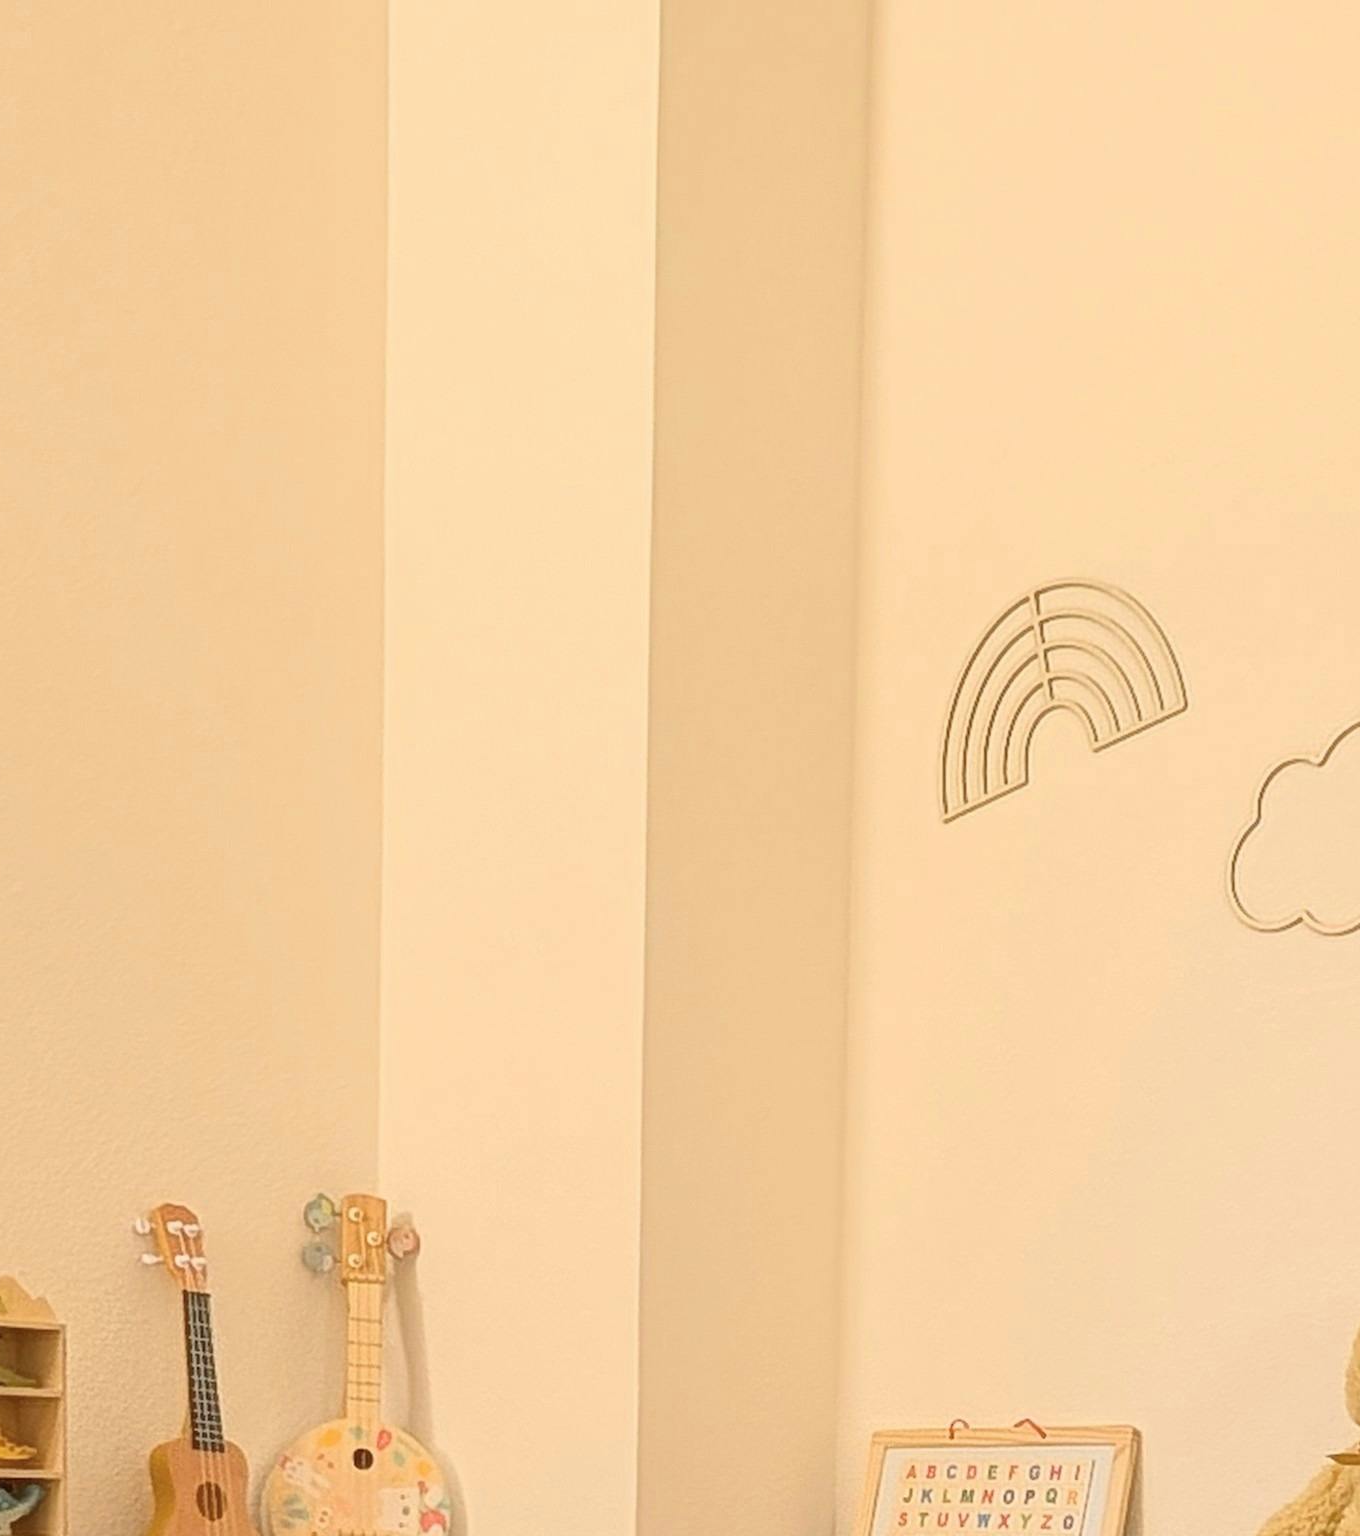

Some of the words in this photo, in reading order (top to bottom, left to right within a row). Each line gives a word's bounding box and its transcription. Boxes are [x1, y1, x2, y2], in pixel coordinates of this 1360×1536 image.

[905, 1464, 917, 1480] A
[925, 1464, 937, 1480] B
[946, 1464, 958, 1480] C
[966, 1464, 978, 1480] D
[987, 1464, 999, 1481] E
[1008, 1464, 1019, 1481] F
[1028, 1464, 1041, 1481] G
[1049, 1464, 1063, 1481] H
[1074, 1464, 1081, 1481] I
[902, 1487, 914, 1504] J
[920, 1488, 933, 1504] K
[941, 1489, 952, 1504] L
[959, 1488, 975, 1504] M
[980, 1489, 995, 1505] N
[1002, 1489, 1015, 1505] O
[1023, 1489, 1036, 1505] P
[1045, 1487, 1058, 1505] Q
[1066, 1490, 1078, 1505] R
[897, 1511, 908, 1527] S
[918, 1511, 929, 1528] T
[936, 1511, 950, 1528] U
[957, 1512, 970, 1528] V
[977, 1512, 992, 1529] W
[997, 1513, 1011, 1530] X
[1020, 1513, 1033, 1530] Y
[1040, 1514, 1053, 1530] Z
